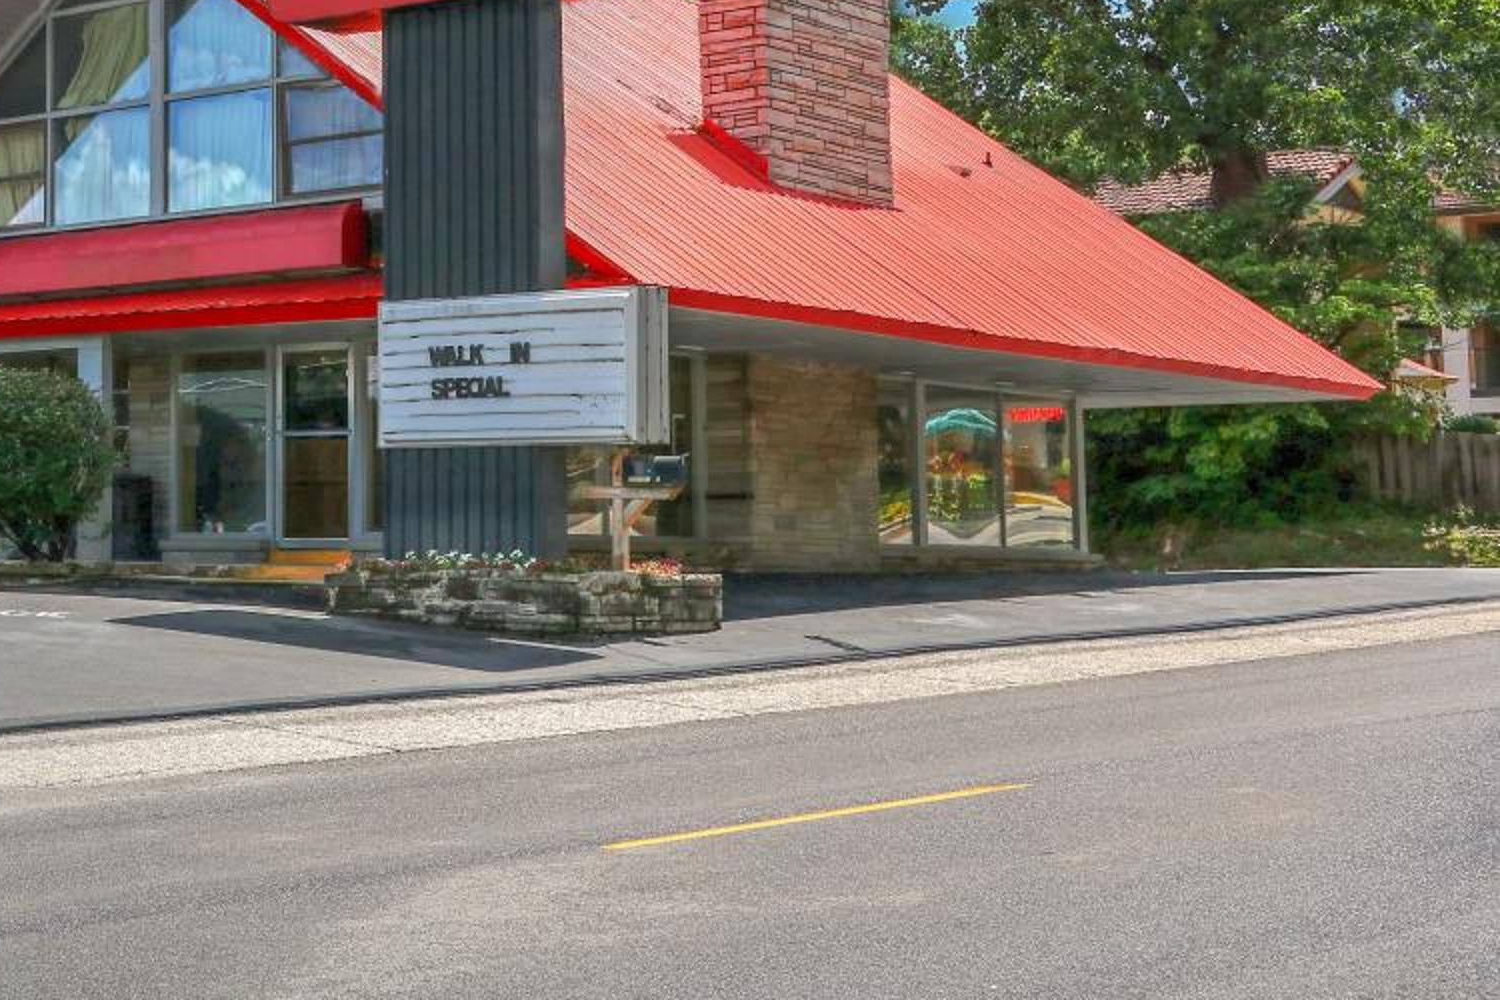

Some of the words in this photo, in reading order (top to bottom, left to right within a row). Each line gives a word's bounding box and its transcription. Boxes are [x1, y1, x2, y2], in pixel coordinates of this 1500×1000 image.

[428, 344, 484, 366] WALK
[510, 341, 531, 364] IN
[431, 376, 511, 399] SPECIAL
